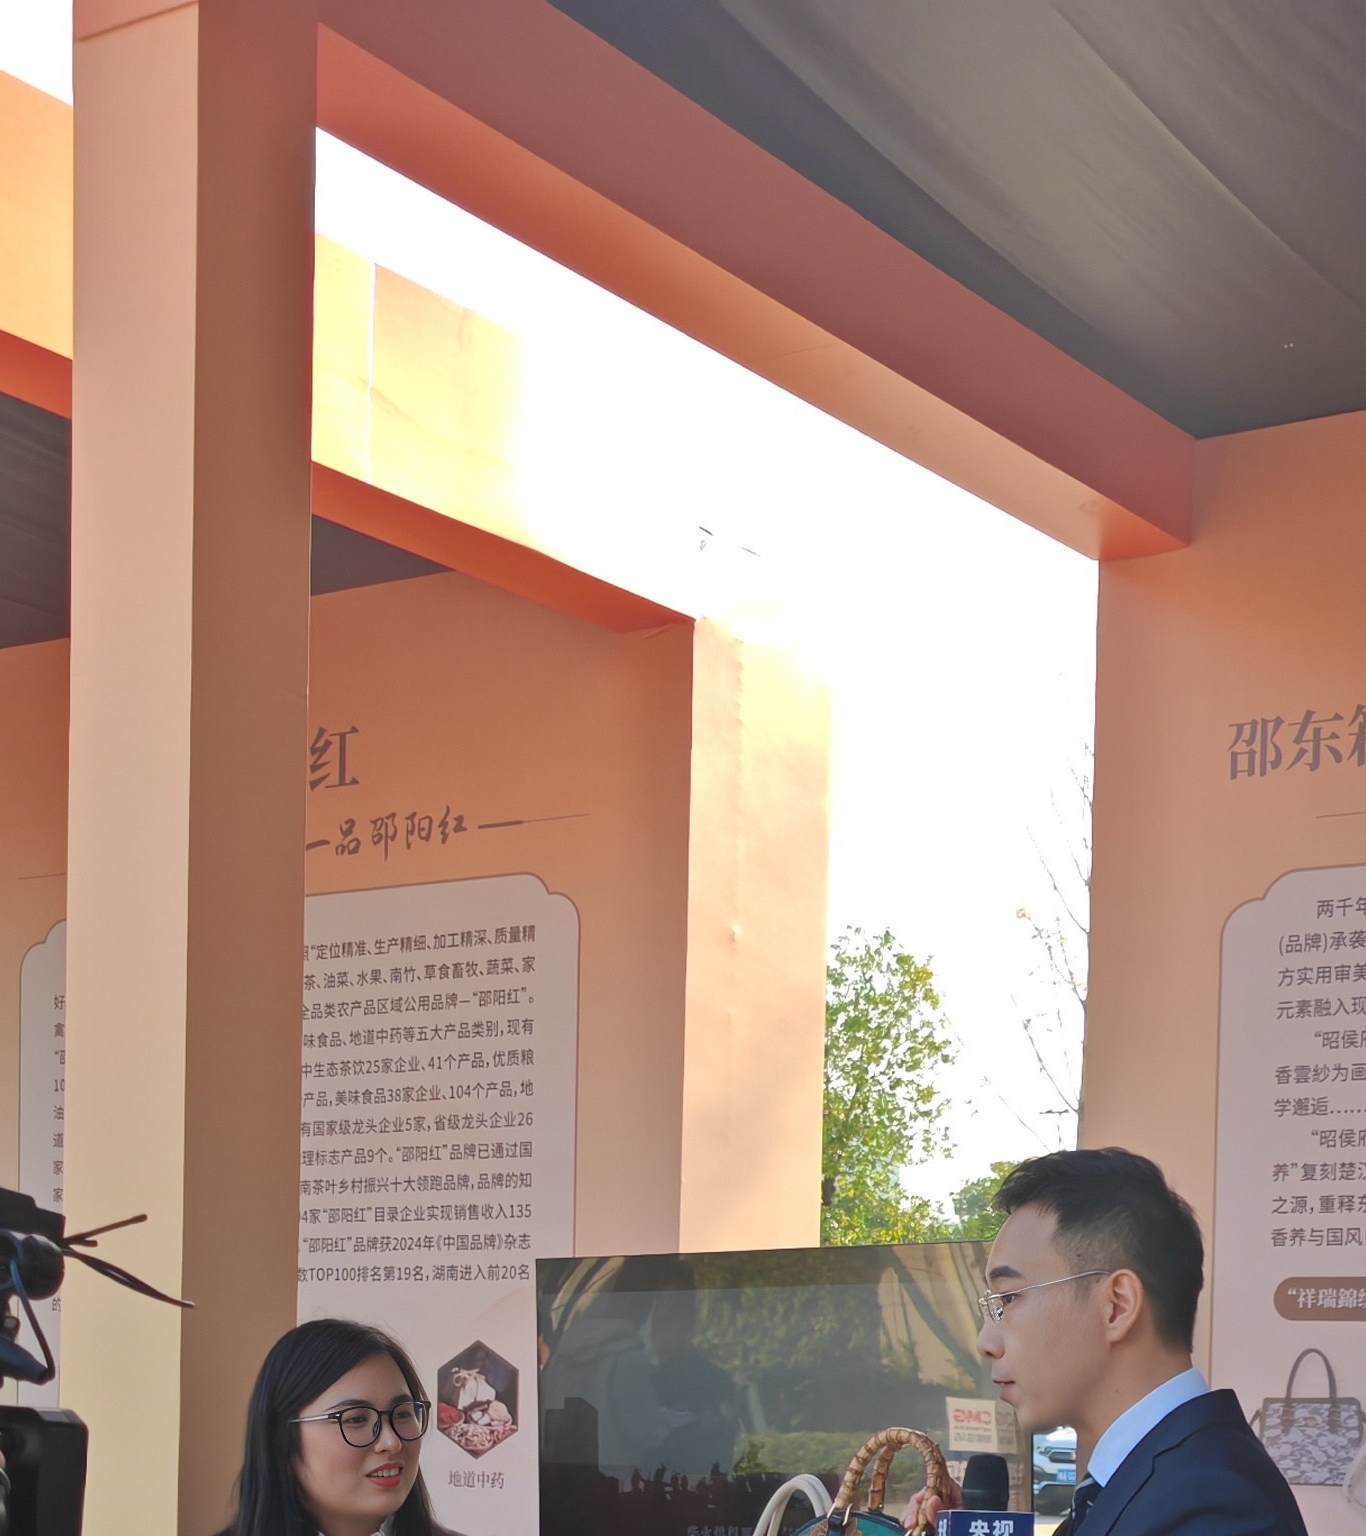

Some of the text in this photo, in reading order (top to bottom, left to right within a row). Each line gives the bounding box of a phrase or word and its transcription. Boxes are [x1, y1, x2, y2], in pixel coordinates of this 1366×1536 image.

[308, 725, 360, 792] 红
[299, 1204, 532, 1224] 4家“邵阳红”目录企业实现销售收入135
[447, 1470, 505, 1490] 地道中药
